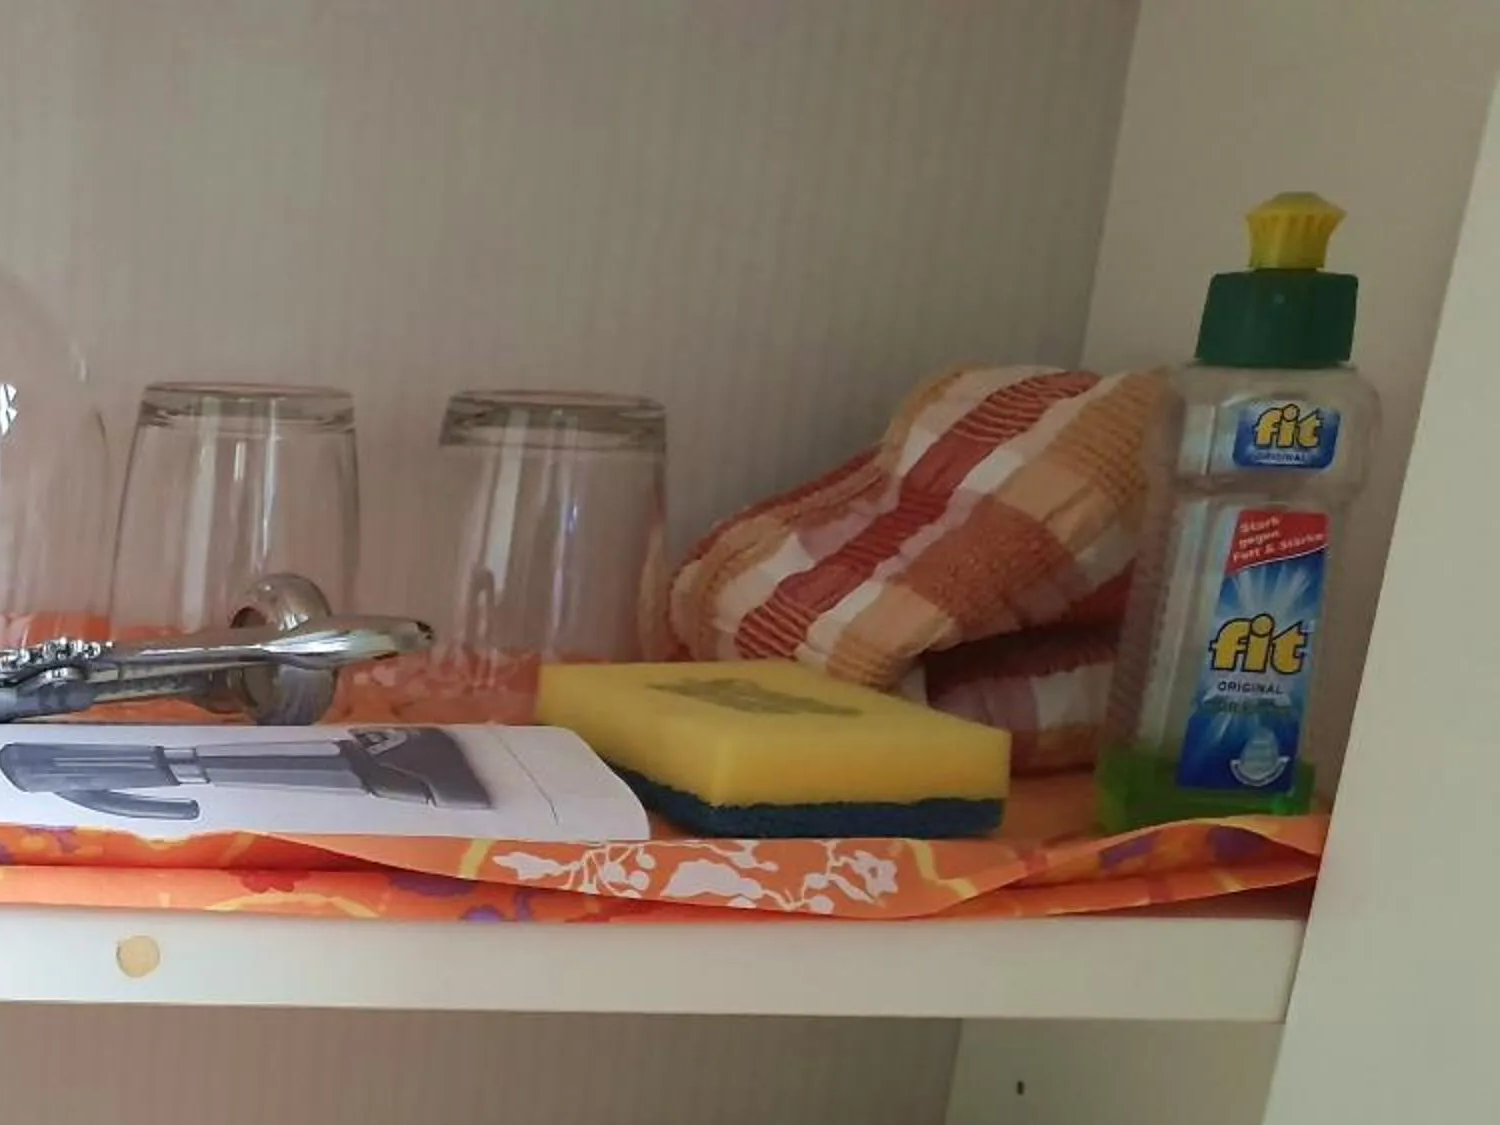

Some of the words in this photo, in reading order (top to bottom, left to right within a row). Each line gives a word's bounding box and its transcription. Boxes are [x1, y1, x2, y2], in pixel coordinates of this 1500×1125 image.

[1252, 403, 1324, 448] fit
[1208, 612, 1308, 675] fit
[1217, 680, 1285, 695] ORIGINAL
